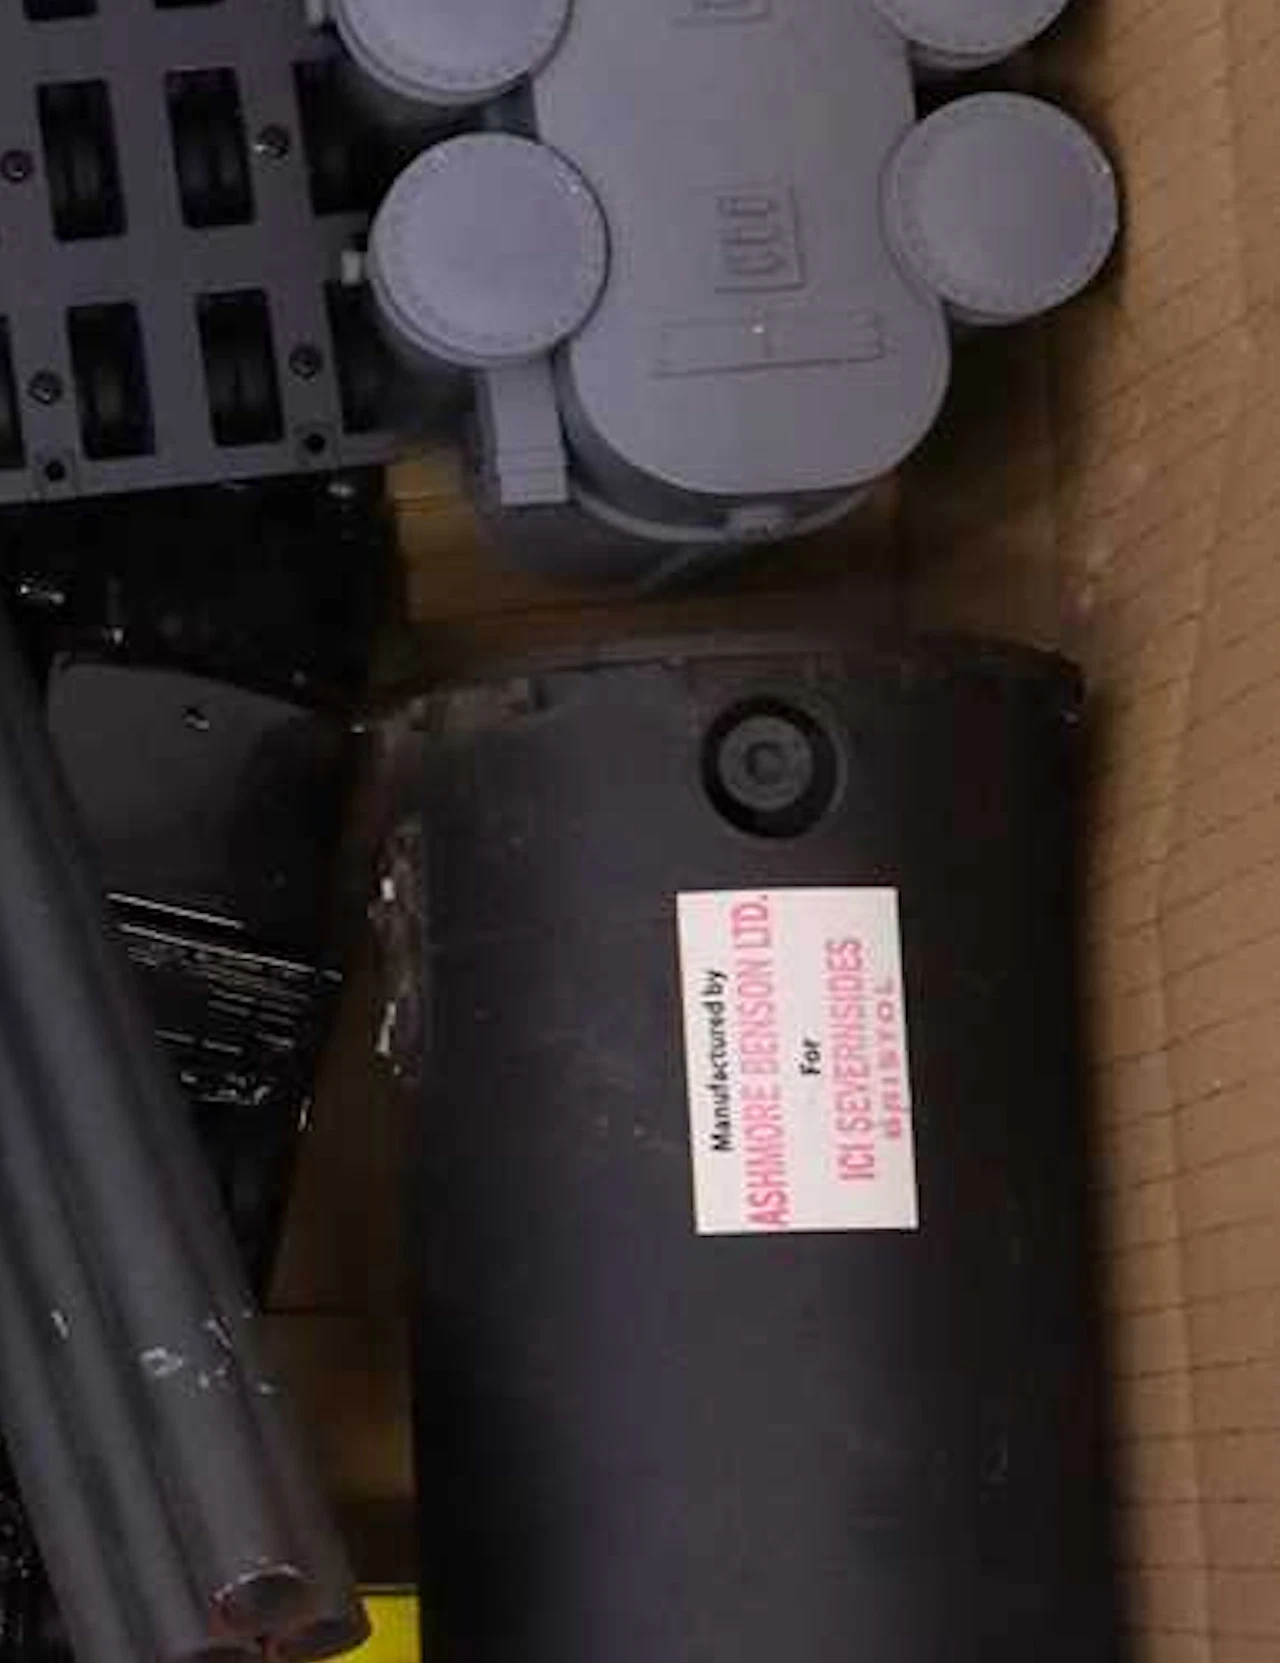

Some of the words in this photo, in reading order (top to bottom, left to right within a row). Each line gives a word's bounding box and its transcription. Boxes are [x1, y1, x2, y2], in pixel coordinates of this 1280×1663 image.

[702, 968, 729, 997] by
[736, 960, 781, 1077] BENSON
[826, 937, 872, 1133] SEVERNSIDES
[702, 1001, 735, 1152] Manufactured
[799, 1038, 822, 1077] For
[741, 1084, 790, 1229] ASHMORE
[837, 1141, 876, 1181] ICI
